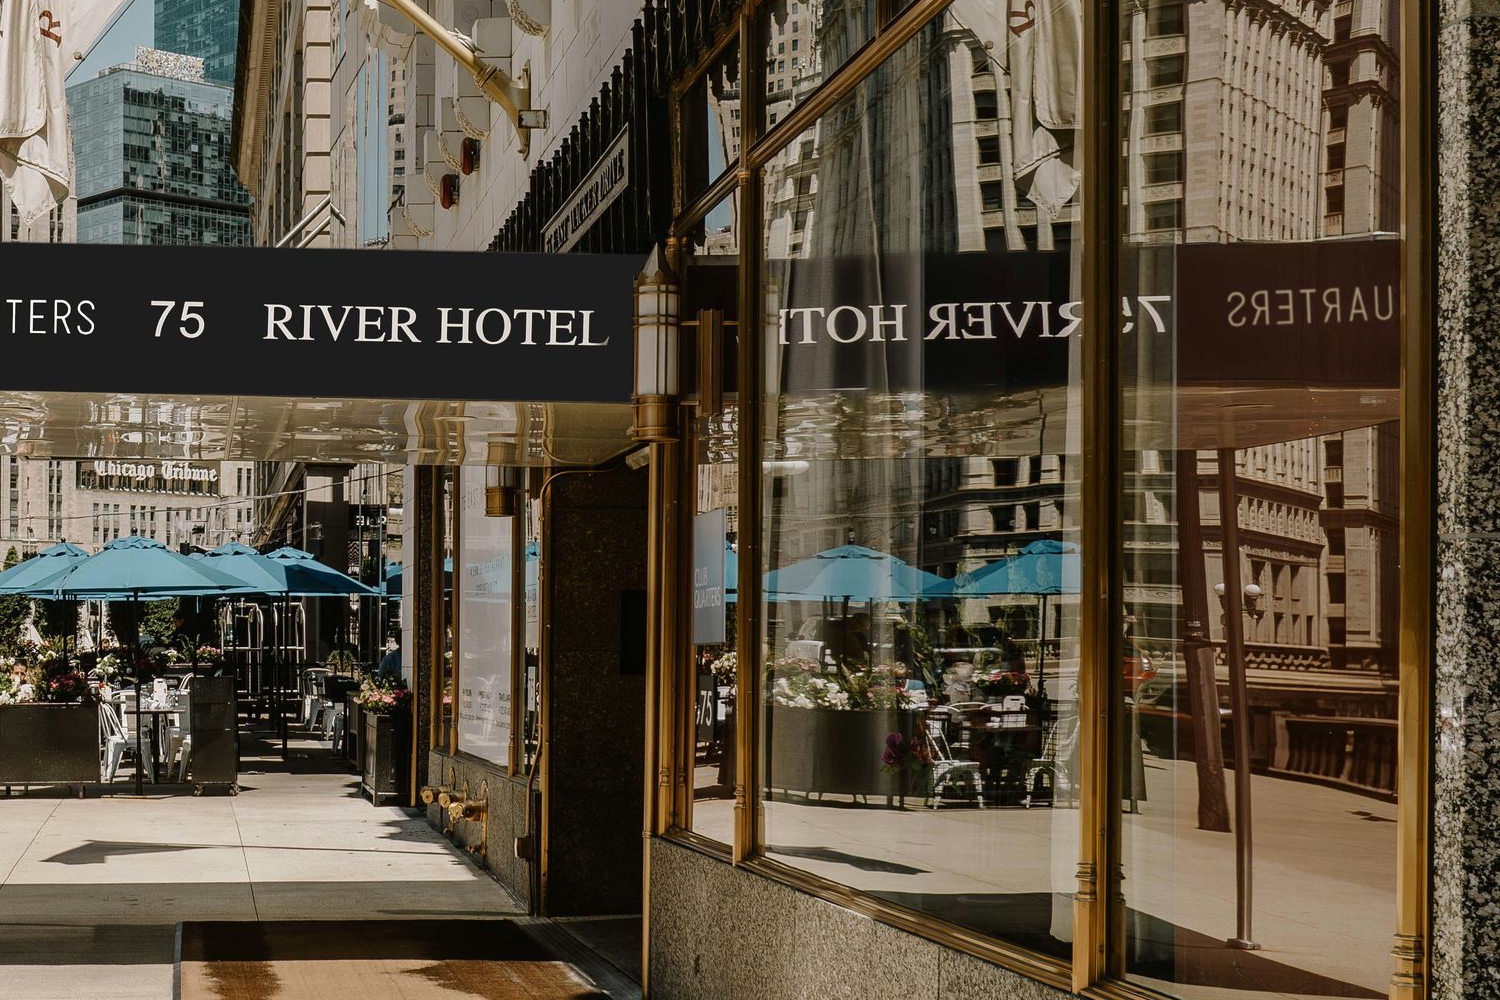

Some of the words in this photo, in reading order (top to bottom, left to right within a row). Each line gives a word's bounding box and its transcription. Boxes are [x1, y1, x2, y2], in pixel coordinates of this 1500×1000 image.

[150, 300, 206, 339] 75
[262, 303, 422, 343] RIVER
[435, 307, 610, 346] HOTEL
[94, 459, 156, 481] Chicago
[161, 459, 220, 482] Tribune
[700, 690, 713, 727] 75
